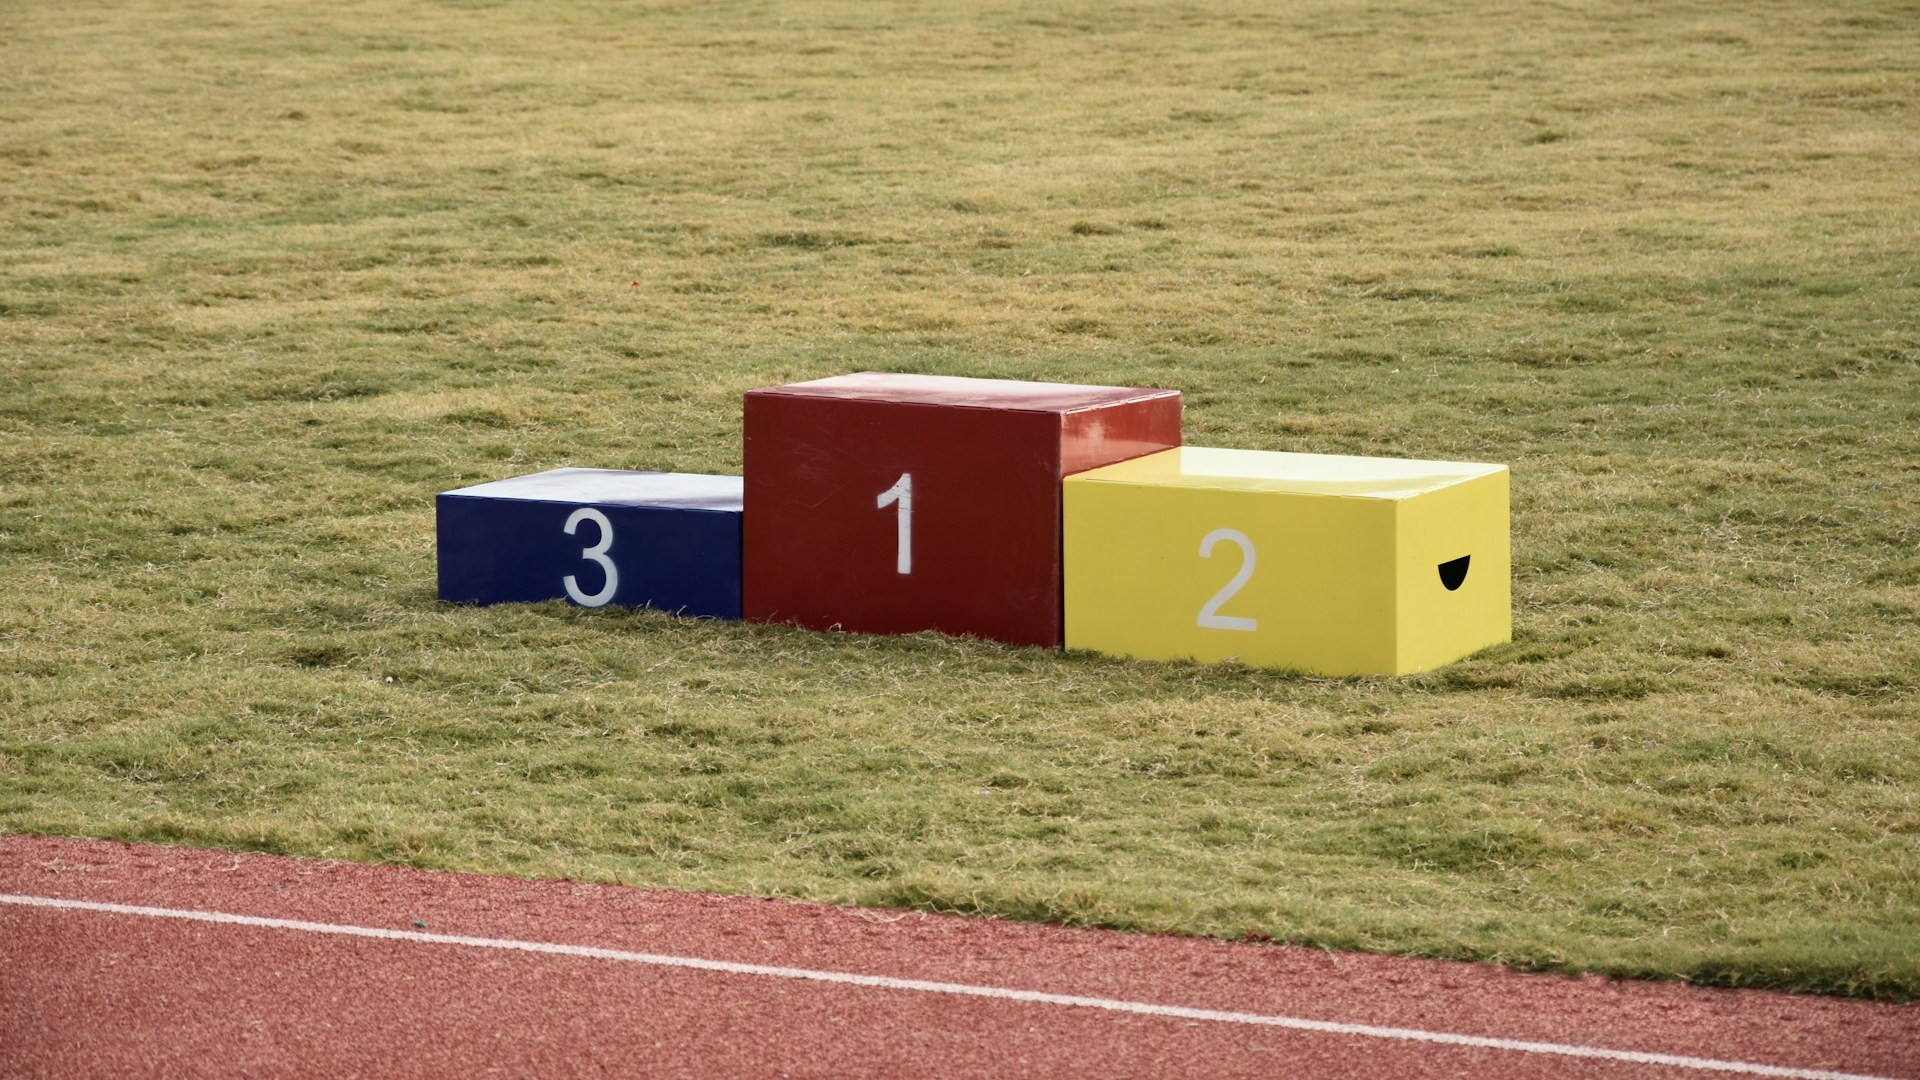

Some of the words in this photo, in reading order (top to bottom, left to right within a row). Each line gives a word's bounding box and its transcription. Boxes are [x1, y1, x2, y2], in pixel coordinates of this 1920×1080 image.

[563, 507, 618, 607] 3
[876, 472, 913, 575] 1
[1196, 528, 1257, 632] 2
